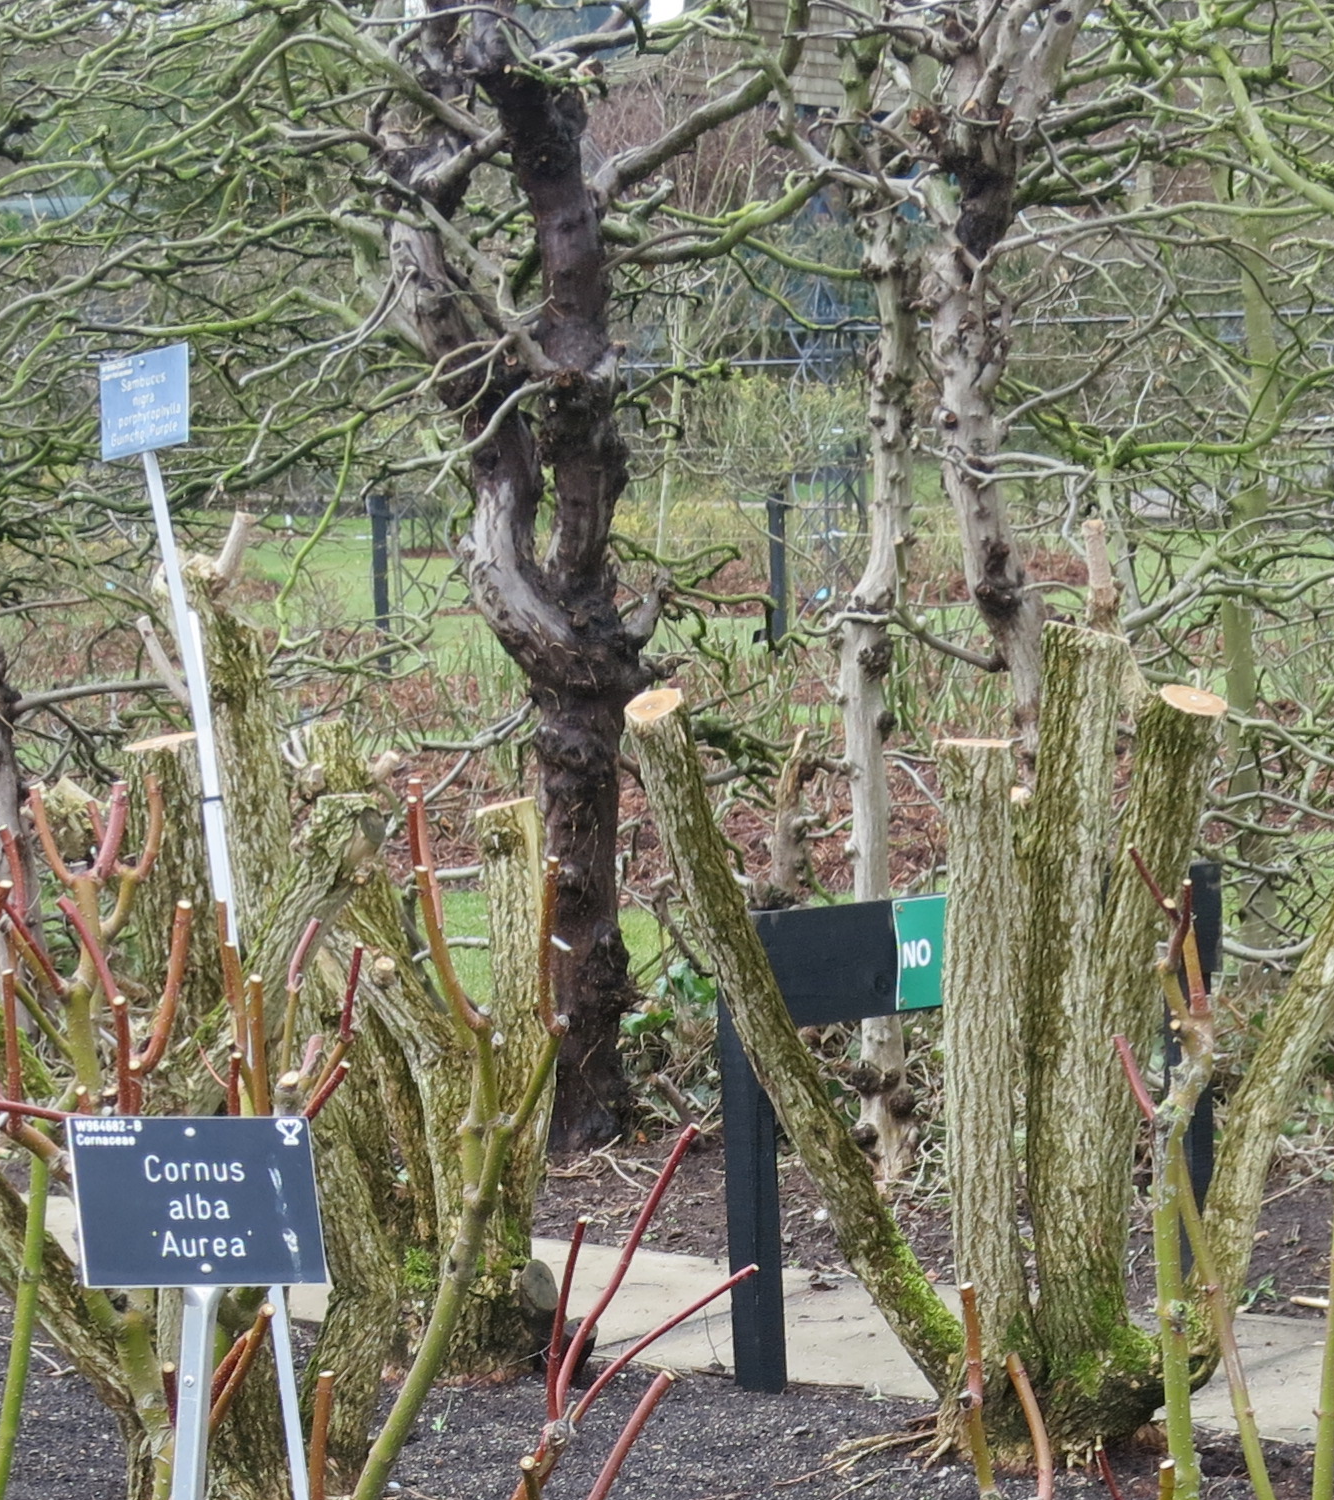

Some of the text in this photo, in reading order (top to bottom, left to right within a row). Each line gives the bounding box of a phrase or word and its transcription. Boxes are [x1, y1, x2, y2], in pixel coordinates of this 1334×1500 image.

[121, 371, 167, 393] Sambucus
[902, 939, 931, 969] NO
[76, 1133, 136, 1146] Cornaceae
[144, 1154, 245, 1183] Cornus
[169, 1193, 231, 1220] alba
